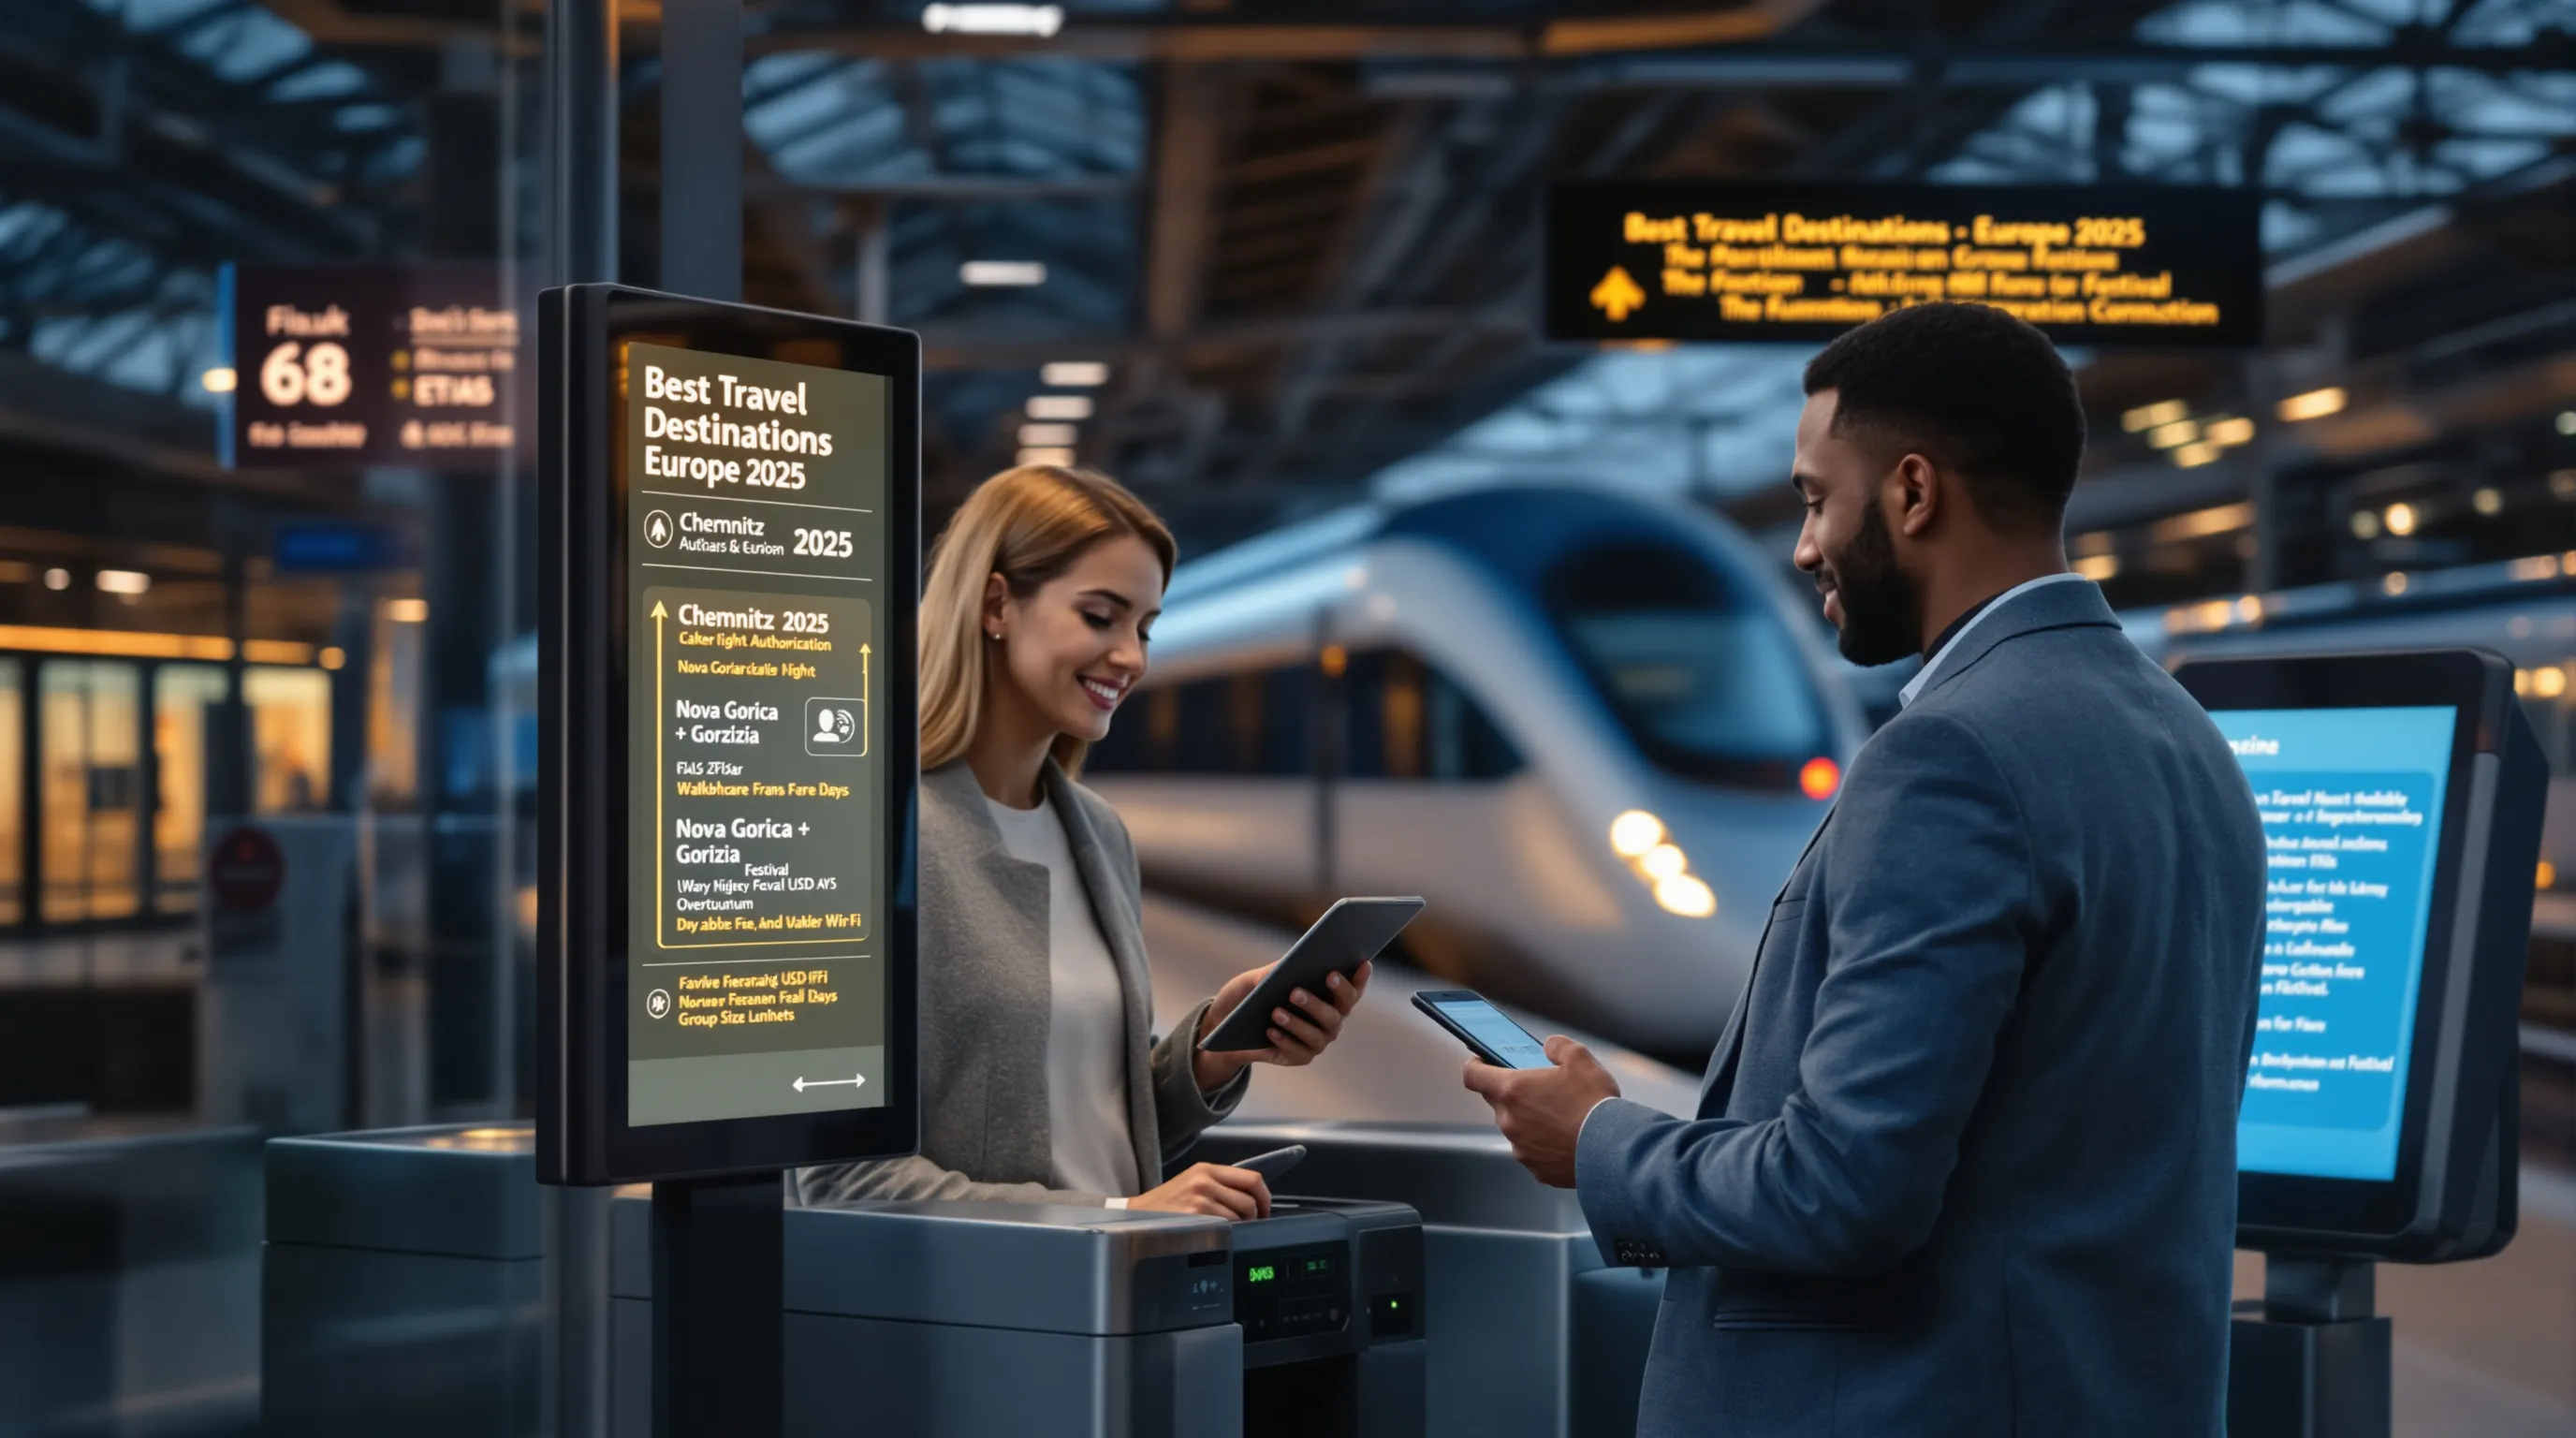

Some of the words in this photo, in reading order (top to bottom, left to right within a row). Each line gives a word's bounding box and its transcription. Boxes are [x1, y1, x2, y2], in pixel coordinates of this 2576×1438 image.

[1624, 213, 1687, 242] Best
[1692, 213, 1778, 242] Travel
[1782, 213, 1950, 244] Destinations
[1972, 214, 2071, 251] Europe
[2074, 217, 2145, 247] 2025
[260, 341, 352, 406] 68
[645, 365, 711, 404] Best
[718, 374, 807, 416] Travel
[645, 406, 833, 457] Destinations
[645, 445, 740, 489] Europe
[745, 458, 806, 490] 2025
[680, 512, 765, 536] Chemnitz
[793, 528, 853, 558] 2025
[679, 604, 775, 631] Chemnitz
[782, 611, 829, 634] 2025
[678, 659, 708, 674] Nova
[676, 699, 721, 719] Nova
[724, 701, 779, 721] Gorica
[675, 727, 686, 741] +
[691, 725, 760, 744] Gorzizia
[676, 818, 725, 839] Nova
[731, 817, 793, 839] Gorica
[798, 822, 811, 836] +
[676, 844, 740, 864] Gorizia
[745, 863, 788, 877] Festival
[787, 877, 814, 891] USD
[781, 971, 807, 986] USD
[679, 1012, 718, 1028] Group
[720, 1010, 745, 1024] Size
